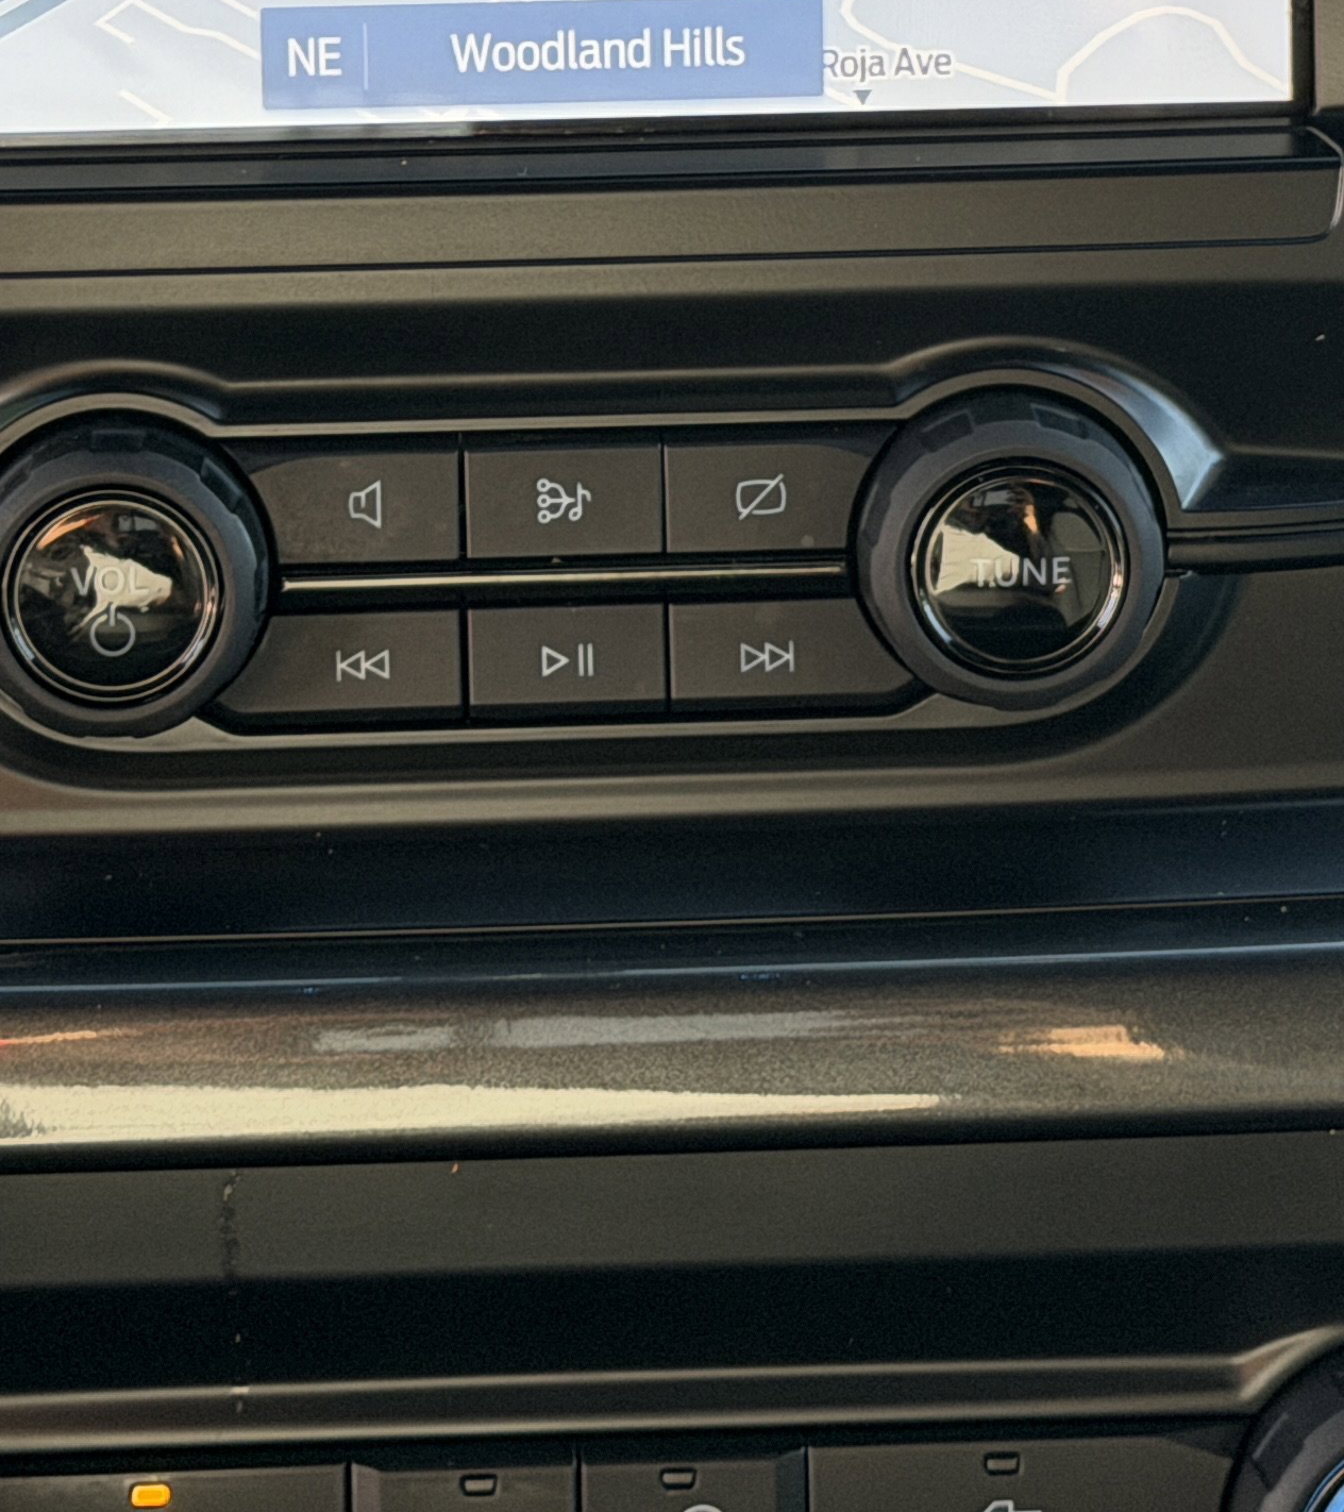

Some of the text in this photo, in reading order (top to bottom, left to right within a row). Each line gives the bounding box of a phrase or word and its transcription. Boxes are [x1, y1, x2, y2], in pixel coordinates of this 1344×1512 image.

[286, 37, 342, 78] NE
[450, 27, 746, 74] Woodland Hills
[823, 48, 952, 83] Roja Ave
[70, 567, 150, 596] VOL
[969, 556, 1071, 588] TUNE
